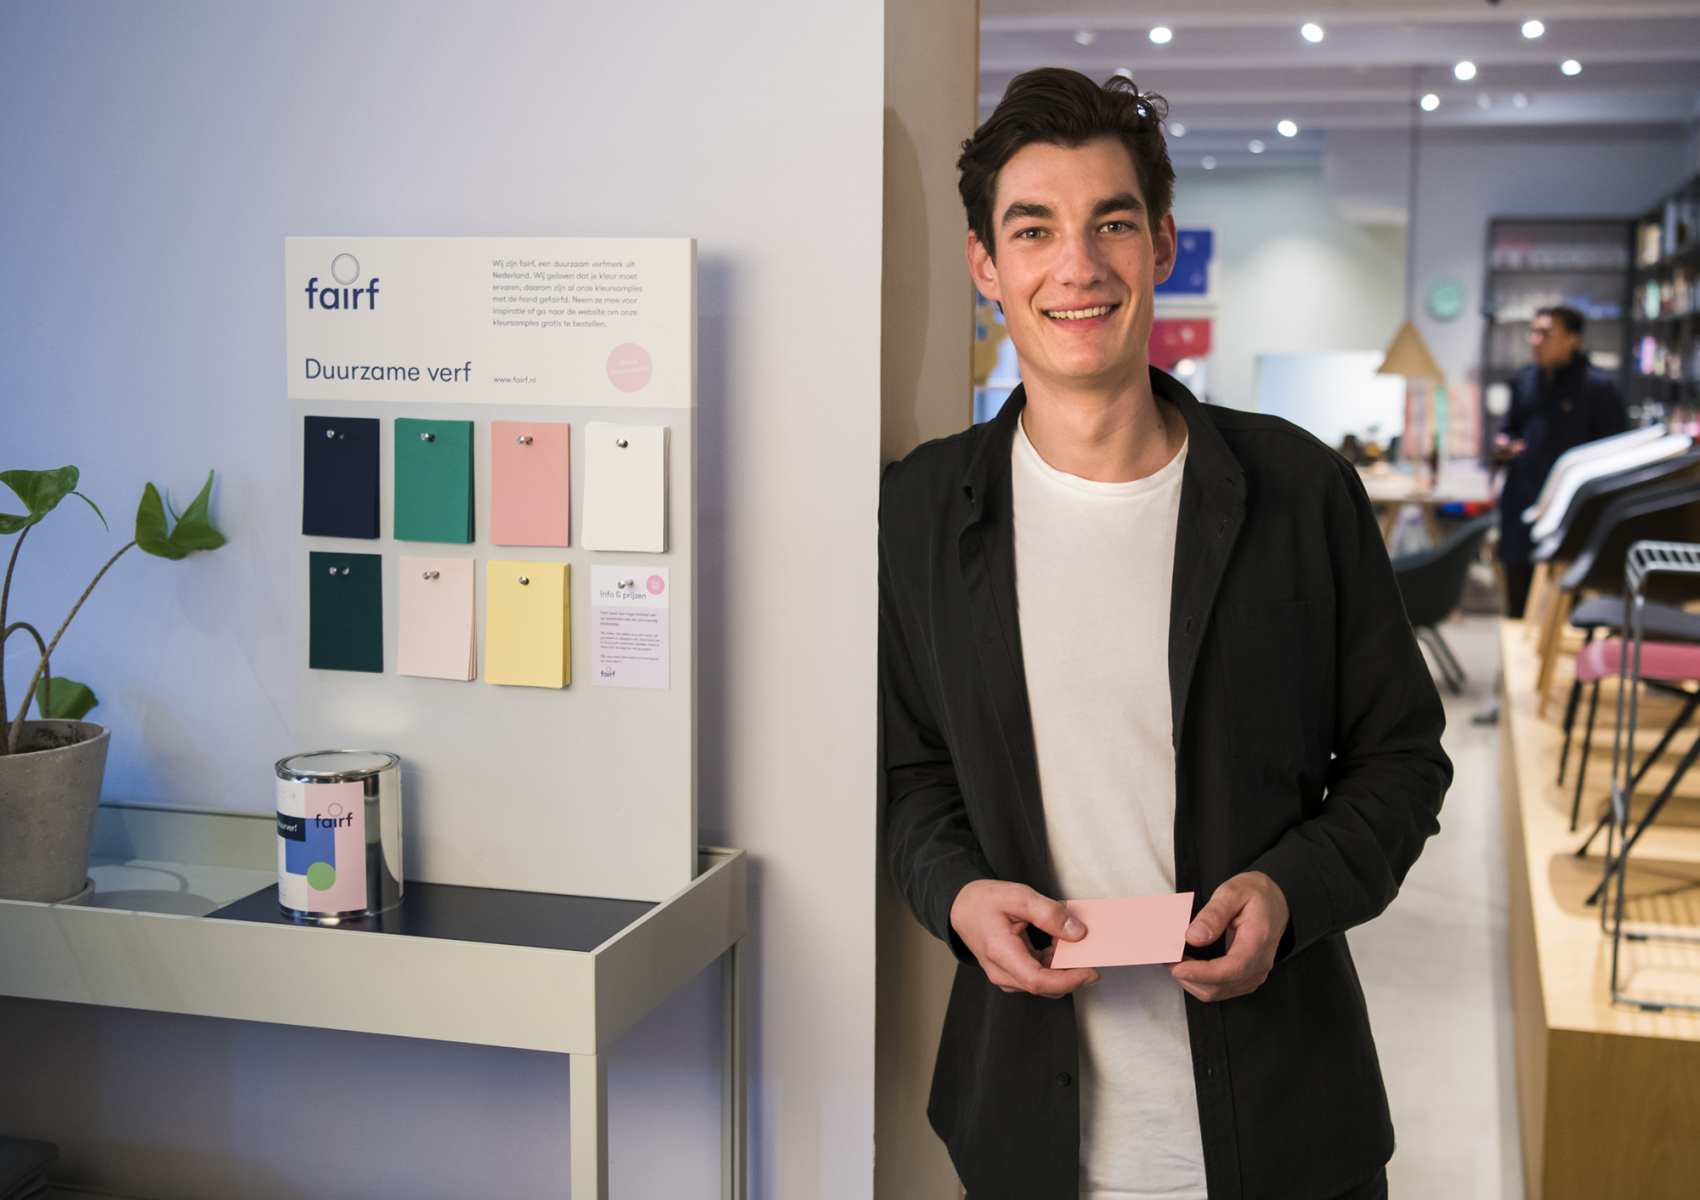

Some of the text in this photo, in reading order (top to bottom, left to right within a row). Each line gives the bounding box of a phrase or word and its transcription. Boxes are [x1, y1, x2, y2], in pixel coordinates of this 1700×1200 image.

[493, 260, 503, 268] Wij
[534, 272, 546, 280] Wij
[591, 273, 597, 281] je
[595, 285, 643, 293] kleursamples
[305, 278, 379, 310] fairf
[305, 358, 472, 383] Duurzame verf
[622, 591, 646, 600] prijzen
[316, 812, 352, 828] fairf
